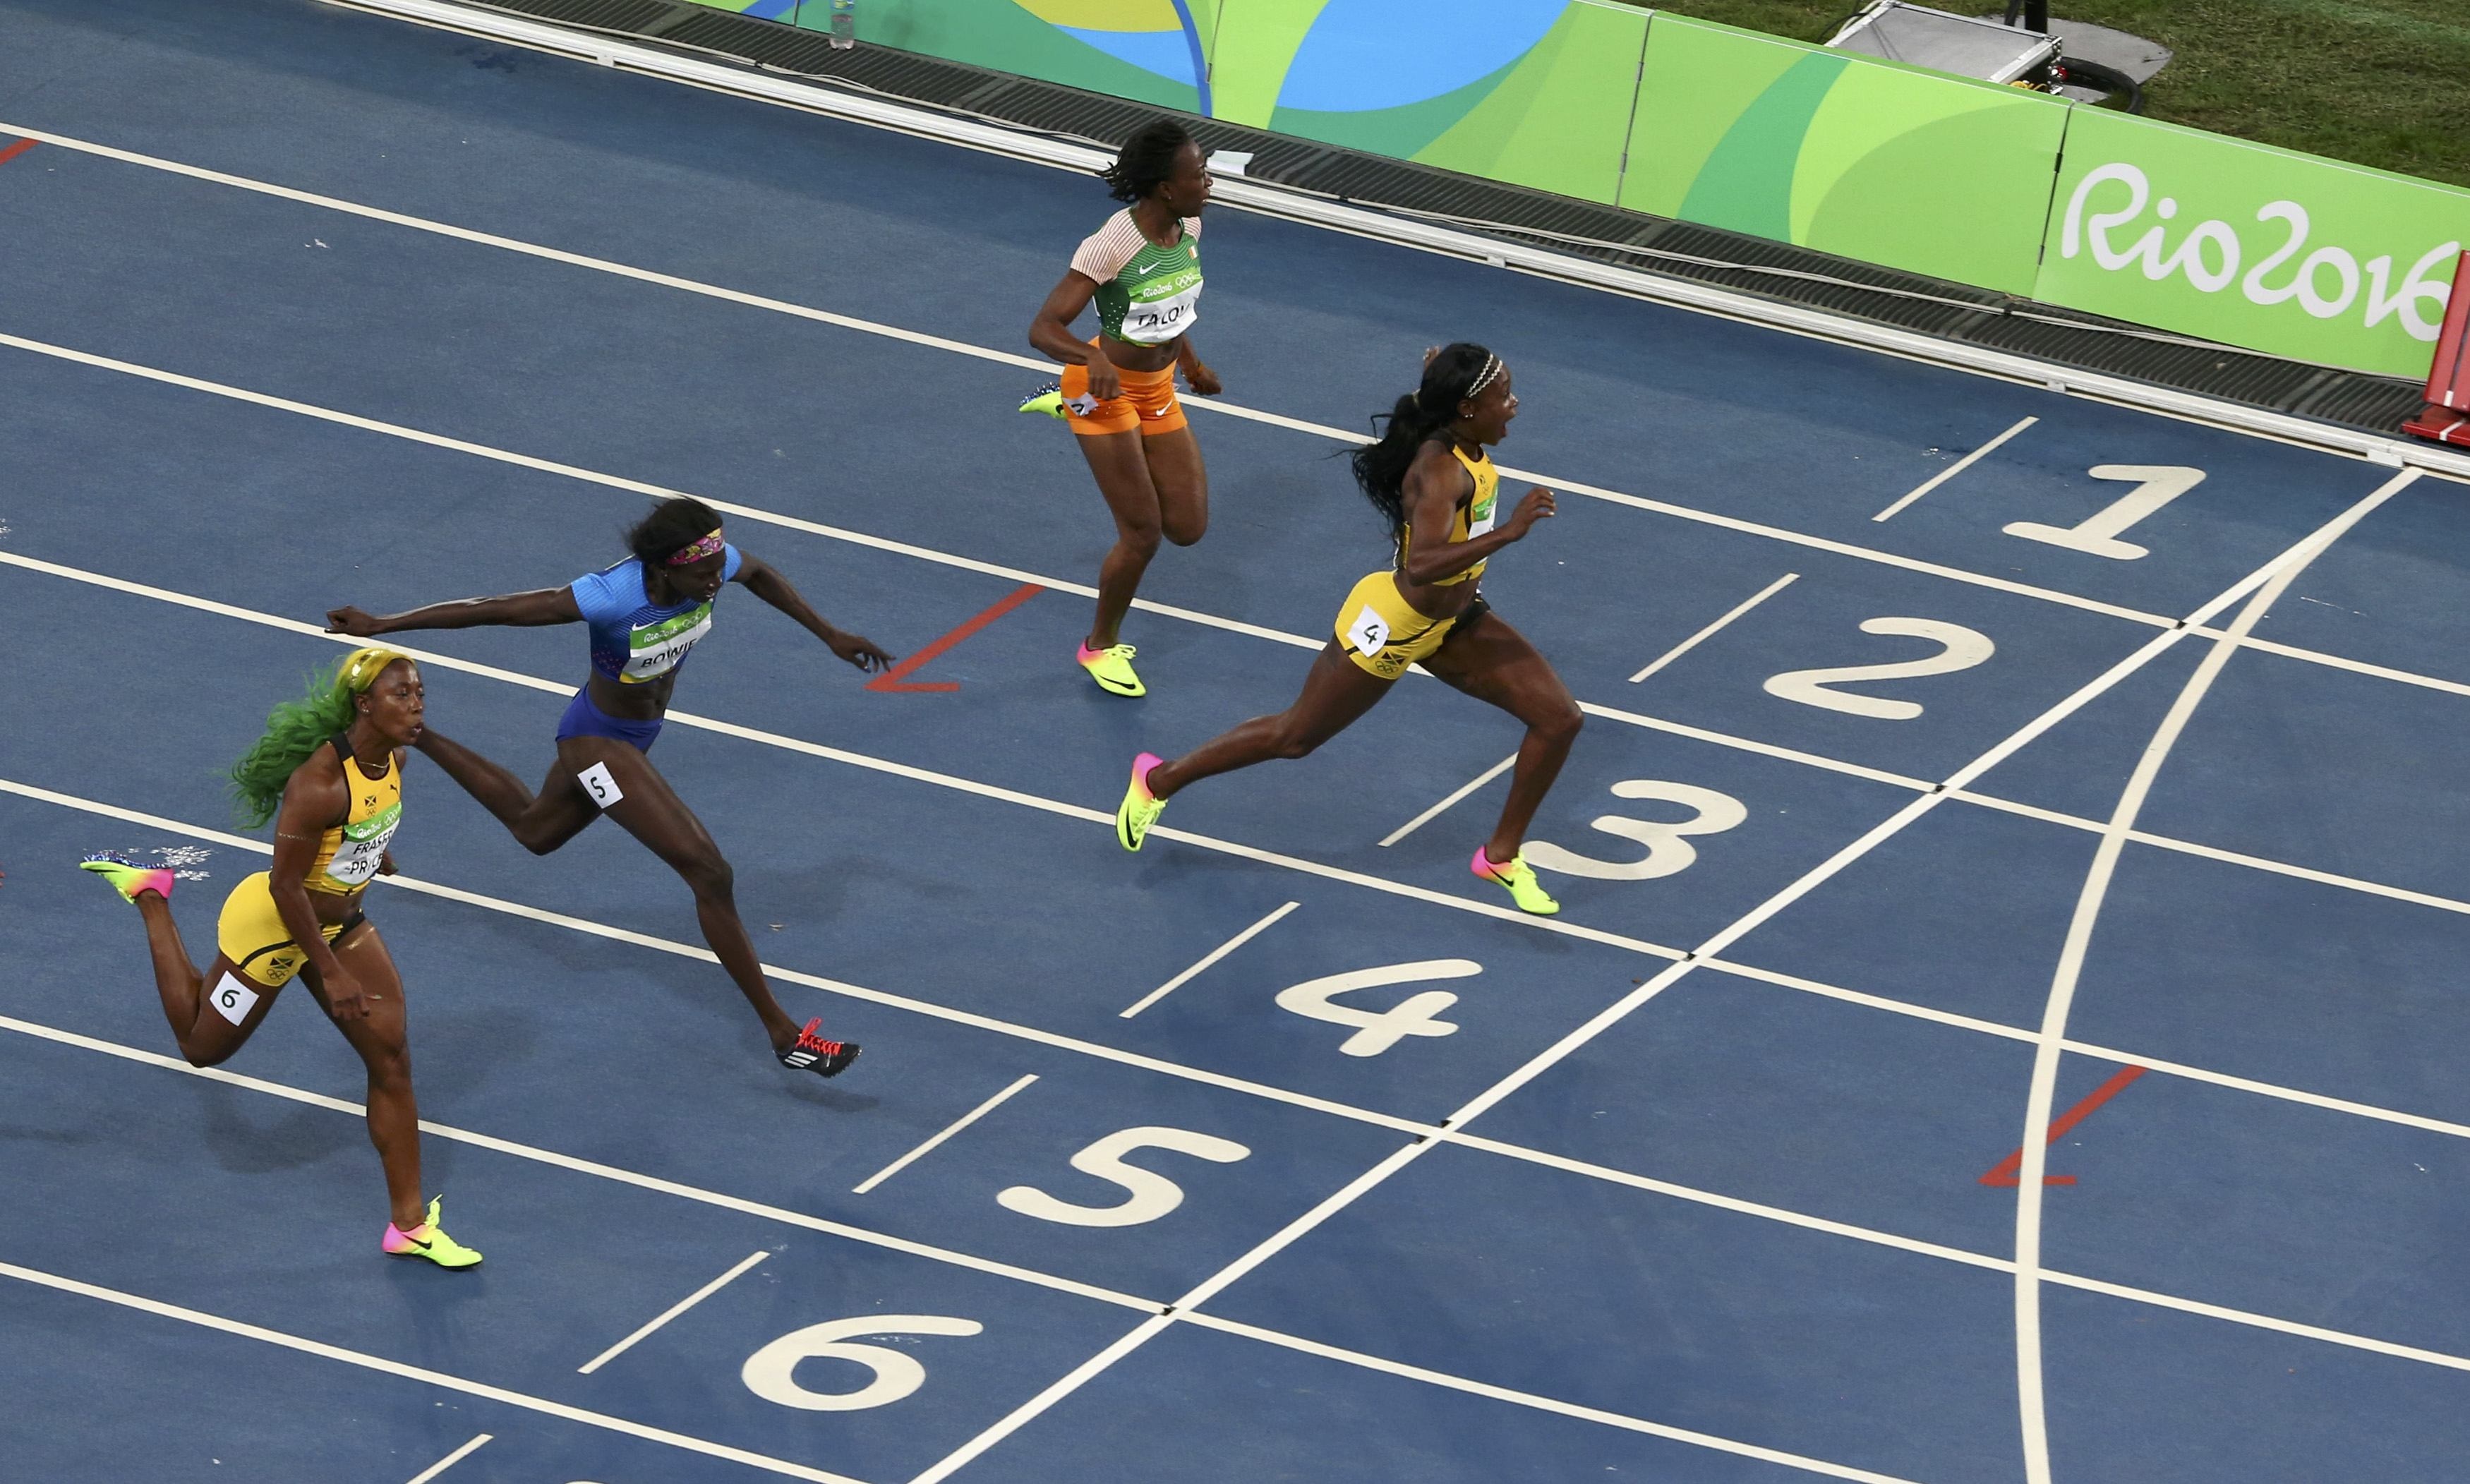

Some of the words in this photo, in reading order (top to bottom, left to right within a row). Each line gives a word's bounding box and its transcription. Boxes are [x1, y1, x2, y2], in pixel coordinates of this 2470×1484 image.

[2001, 464, 2206, 560] 1
[1363, 625, 1379, 645] 4
[1762, 617, 1995, 720] 2
[590, 776, 606, 799] 5
[1519, 780, 1748, 881] 3
[221, 989, 241, 1008] 6
[1275, 958, 1483, 1057] 4
[996, 1126, 1251, 1227] 5
[741, 1315, 984, 1411] 6
